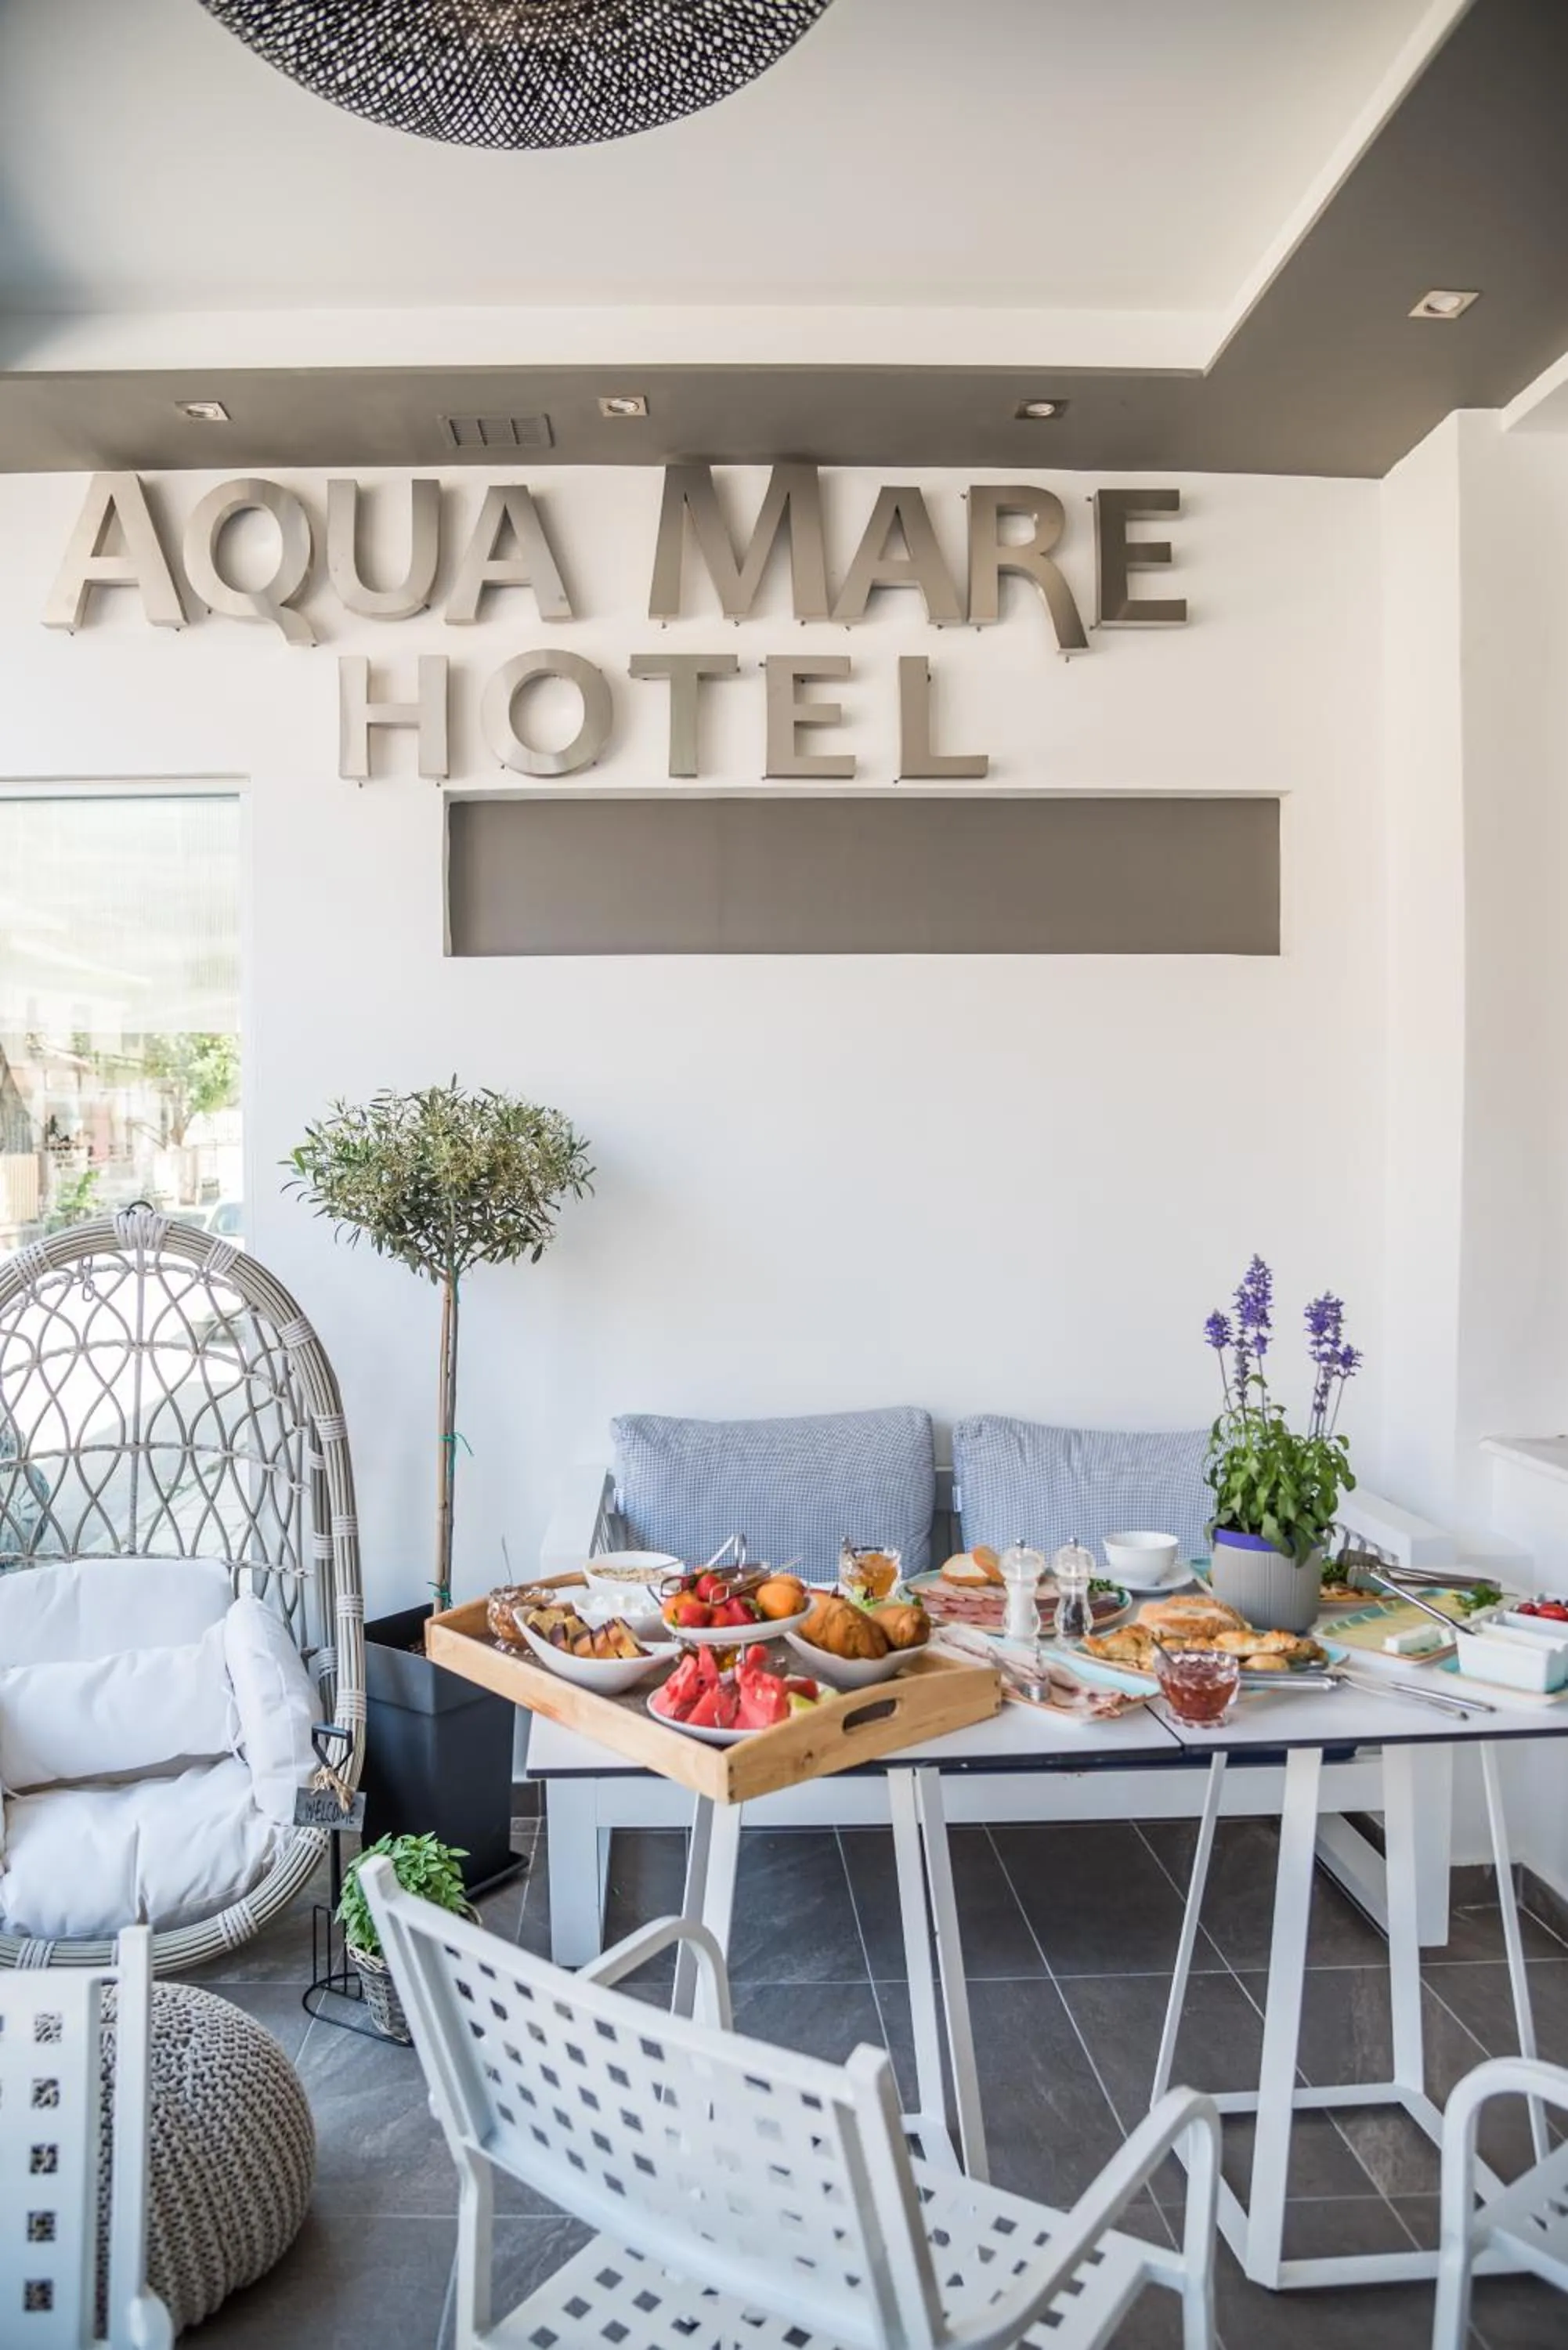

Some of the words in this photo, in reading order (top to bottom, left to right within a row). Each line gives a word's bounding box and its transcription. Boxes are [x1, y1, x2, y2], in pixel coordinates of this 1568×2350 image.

[41, 472, 575, 647] AQUA
[649, 462, 1188, 655] MARE
[338, 648, 989, 779] HOTEL
